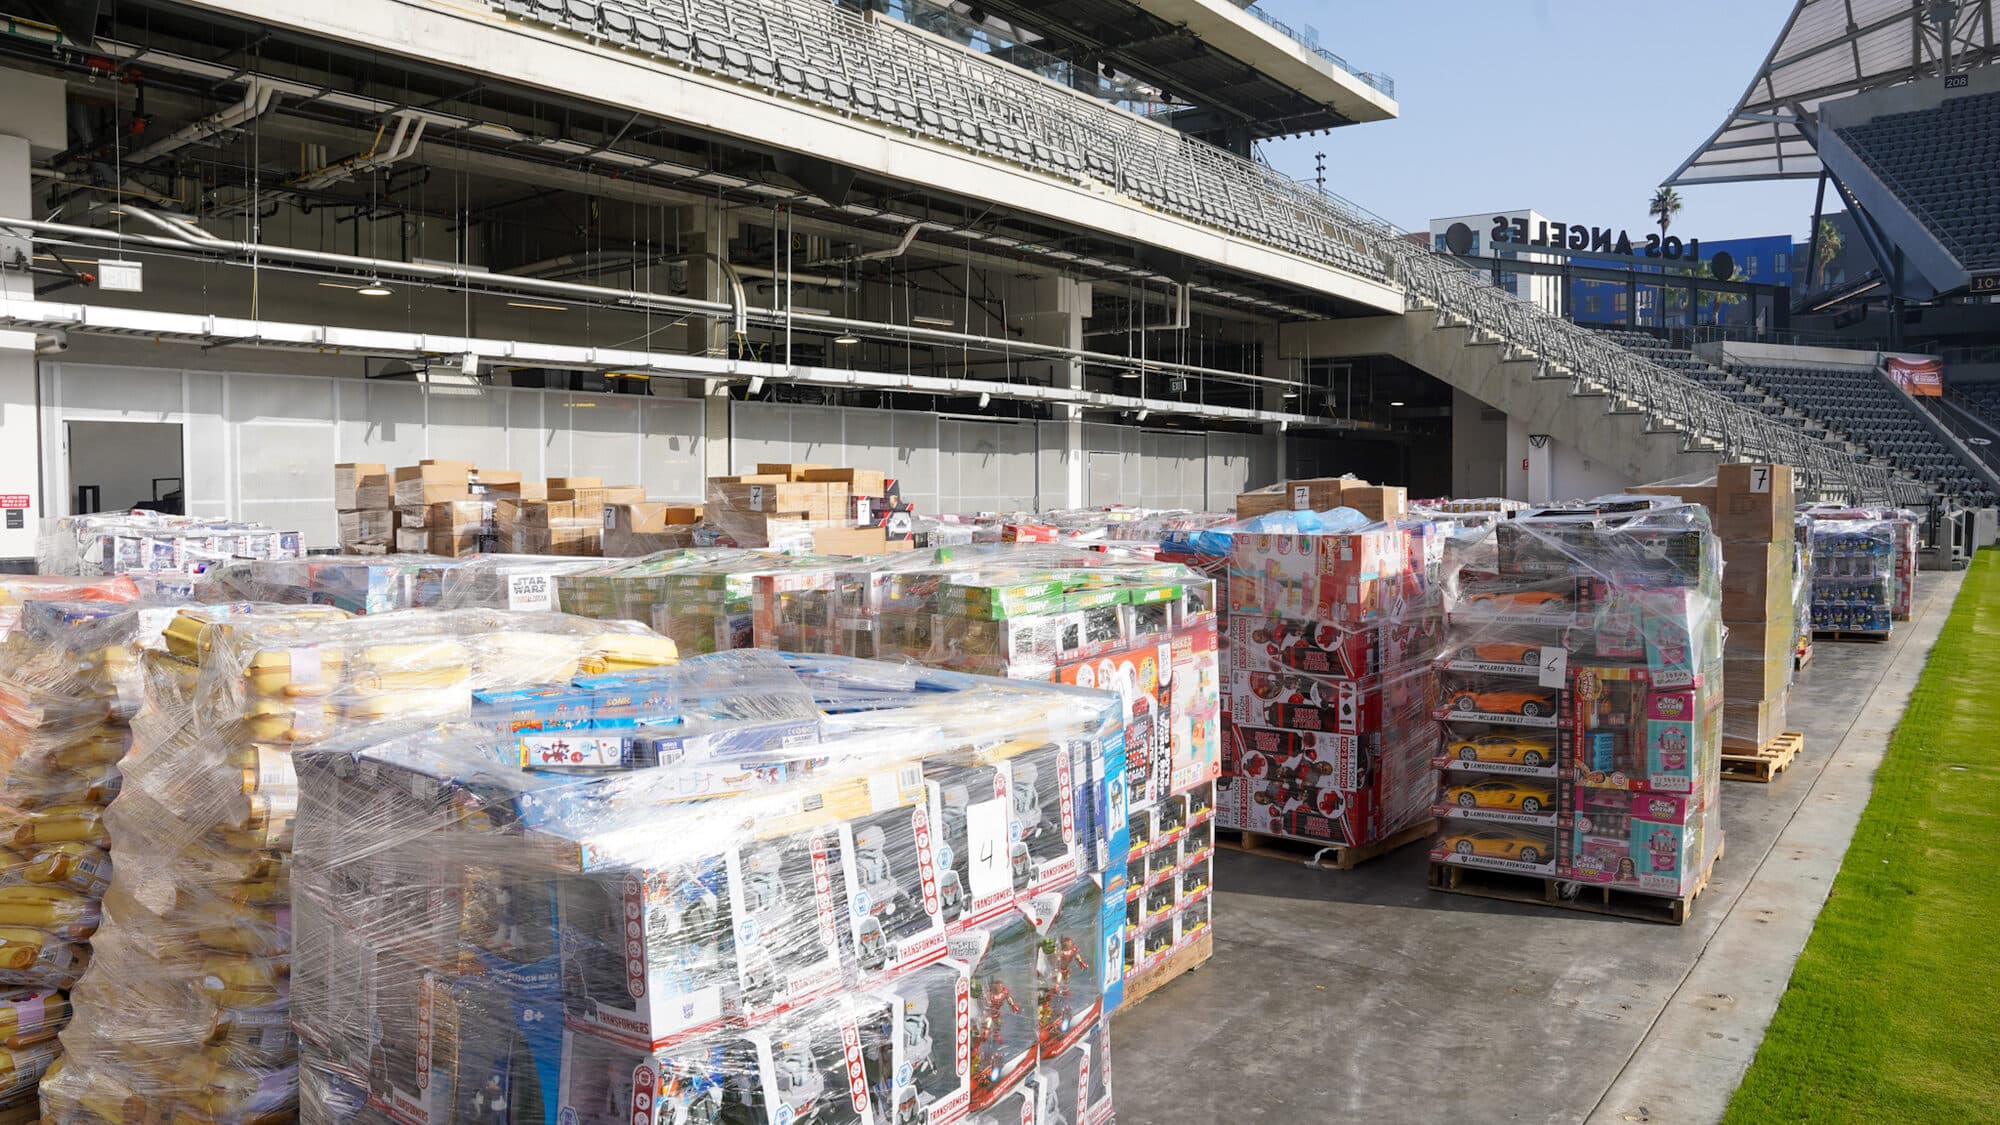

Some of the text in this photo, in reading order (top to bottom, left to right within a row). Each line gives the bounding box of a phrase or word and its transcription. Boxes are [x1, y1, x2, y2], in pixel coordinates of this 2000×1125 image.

[1946, 78, 1966, 88] 208
[1754, 468, 1767, 490] 7
[752, 486, 761, 504] 7
[1296, 488, 1307, 503] 7
[512, 576, 546, 586] STAR
[513, 585, 546, 594] WARS
[1544, 656, 1558, 672] 6
[1470, 762, 1538, 774] LAMBORGHINI AVENTADOR
[1470, 810, 1538, 822] LAMBORGHINI AVENTADOR
[980, 840, 992, 869] 4
[1040, 859, 1075, 879] TRANSFORMERS
[1468, 856, 1536, 870] LAMBORGHINI AVENTADOR
[974, 888, 1012, 910] TRANSFORMERS
[900, 932, 944, 960] TRANSFORMERS
[524, 1008, 544, 1022] 8+
[599, 1010, 649, 1034] TRANSFORMERS
[929, 1090, 969, 1121] TRANSFORMERS
